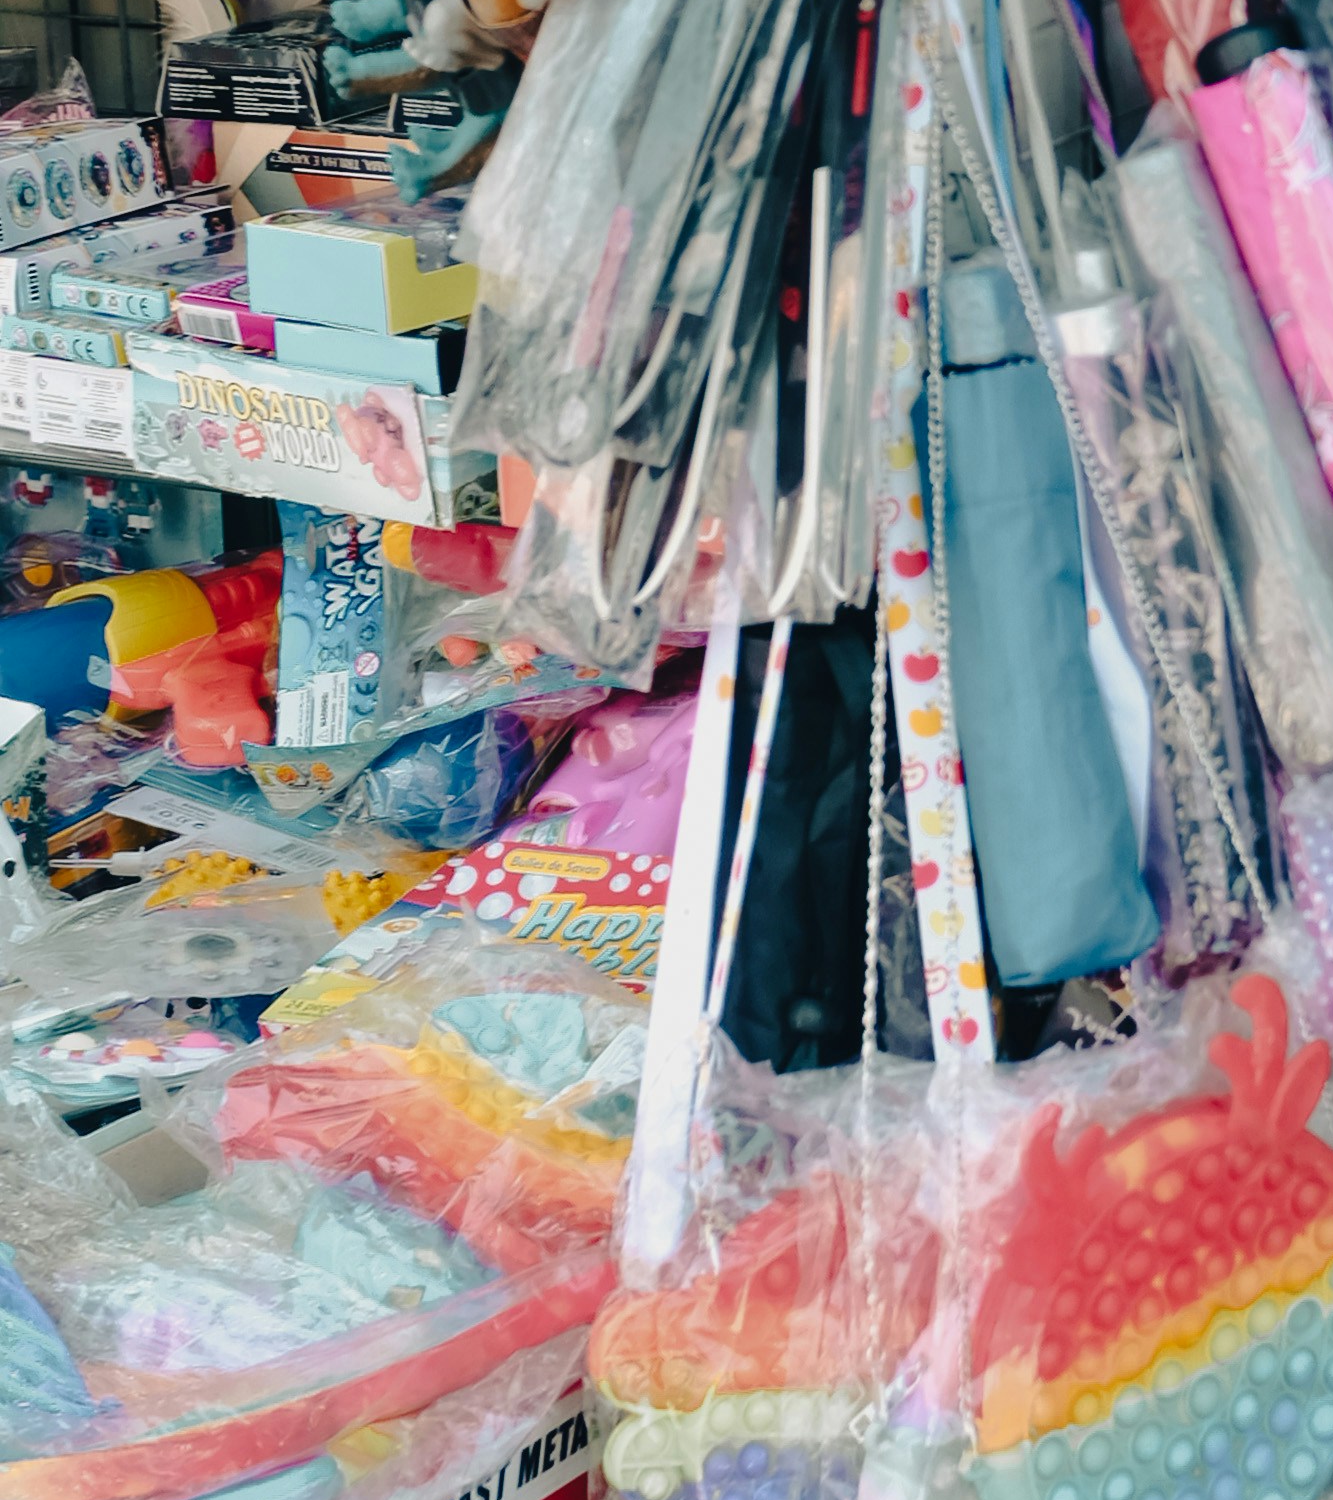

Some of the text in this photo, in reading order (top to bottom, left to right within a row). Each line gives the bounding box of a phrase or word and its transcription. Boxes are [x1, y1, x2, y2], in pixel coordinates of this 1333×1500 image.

[176, 370, 332, 433] DINOSAUR
[262, 418, 342, 473] WORLD
[323, 512, 352, 630] WATE
[514, 895, 666, 952] Happ
[516, 1411, 588, 1490] META
